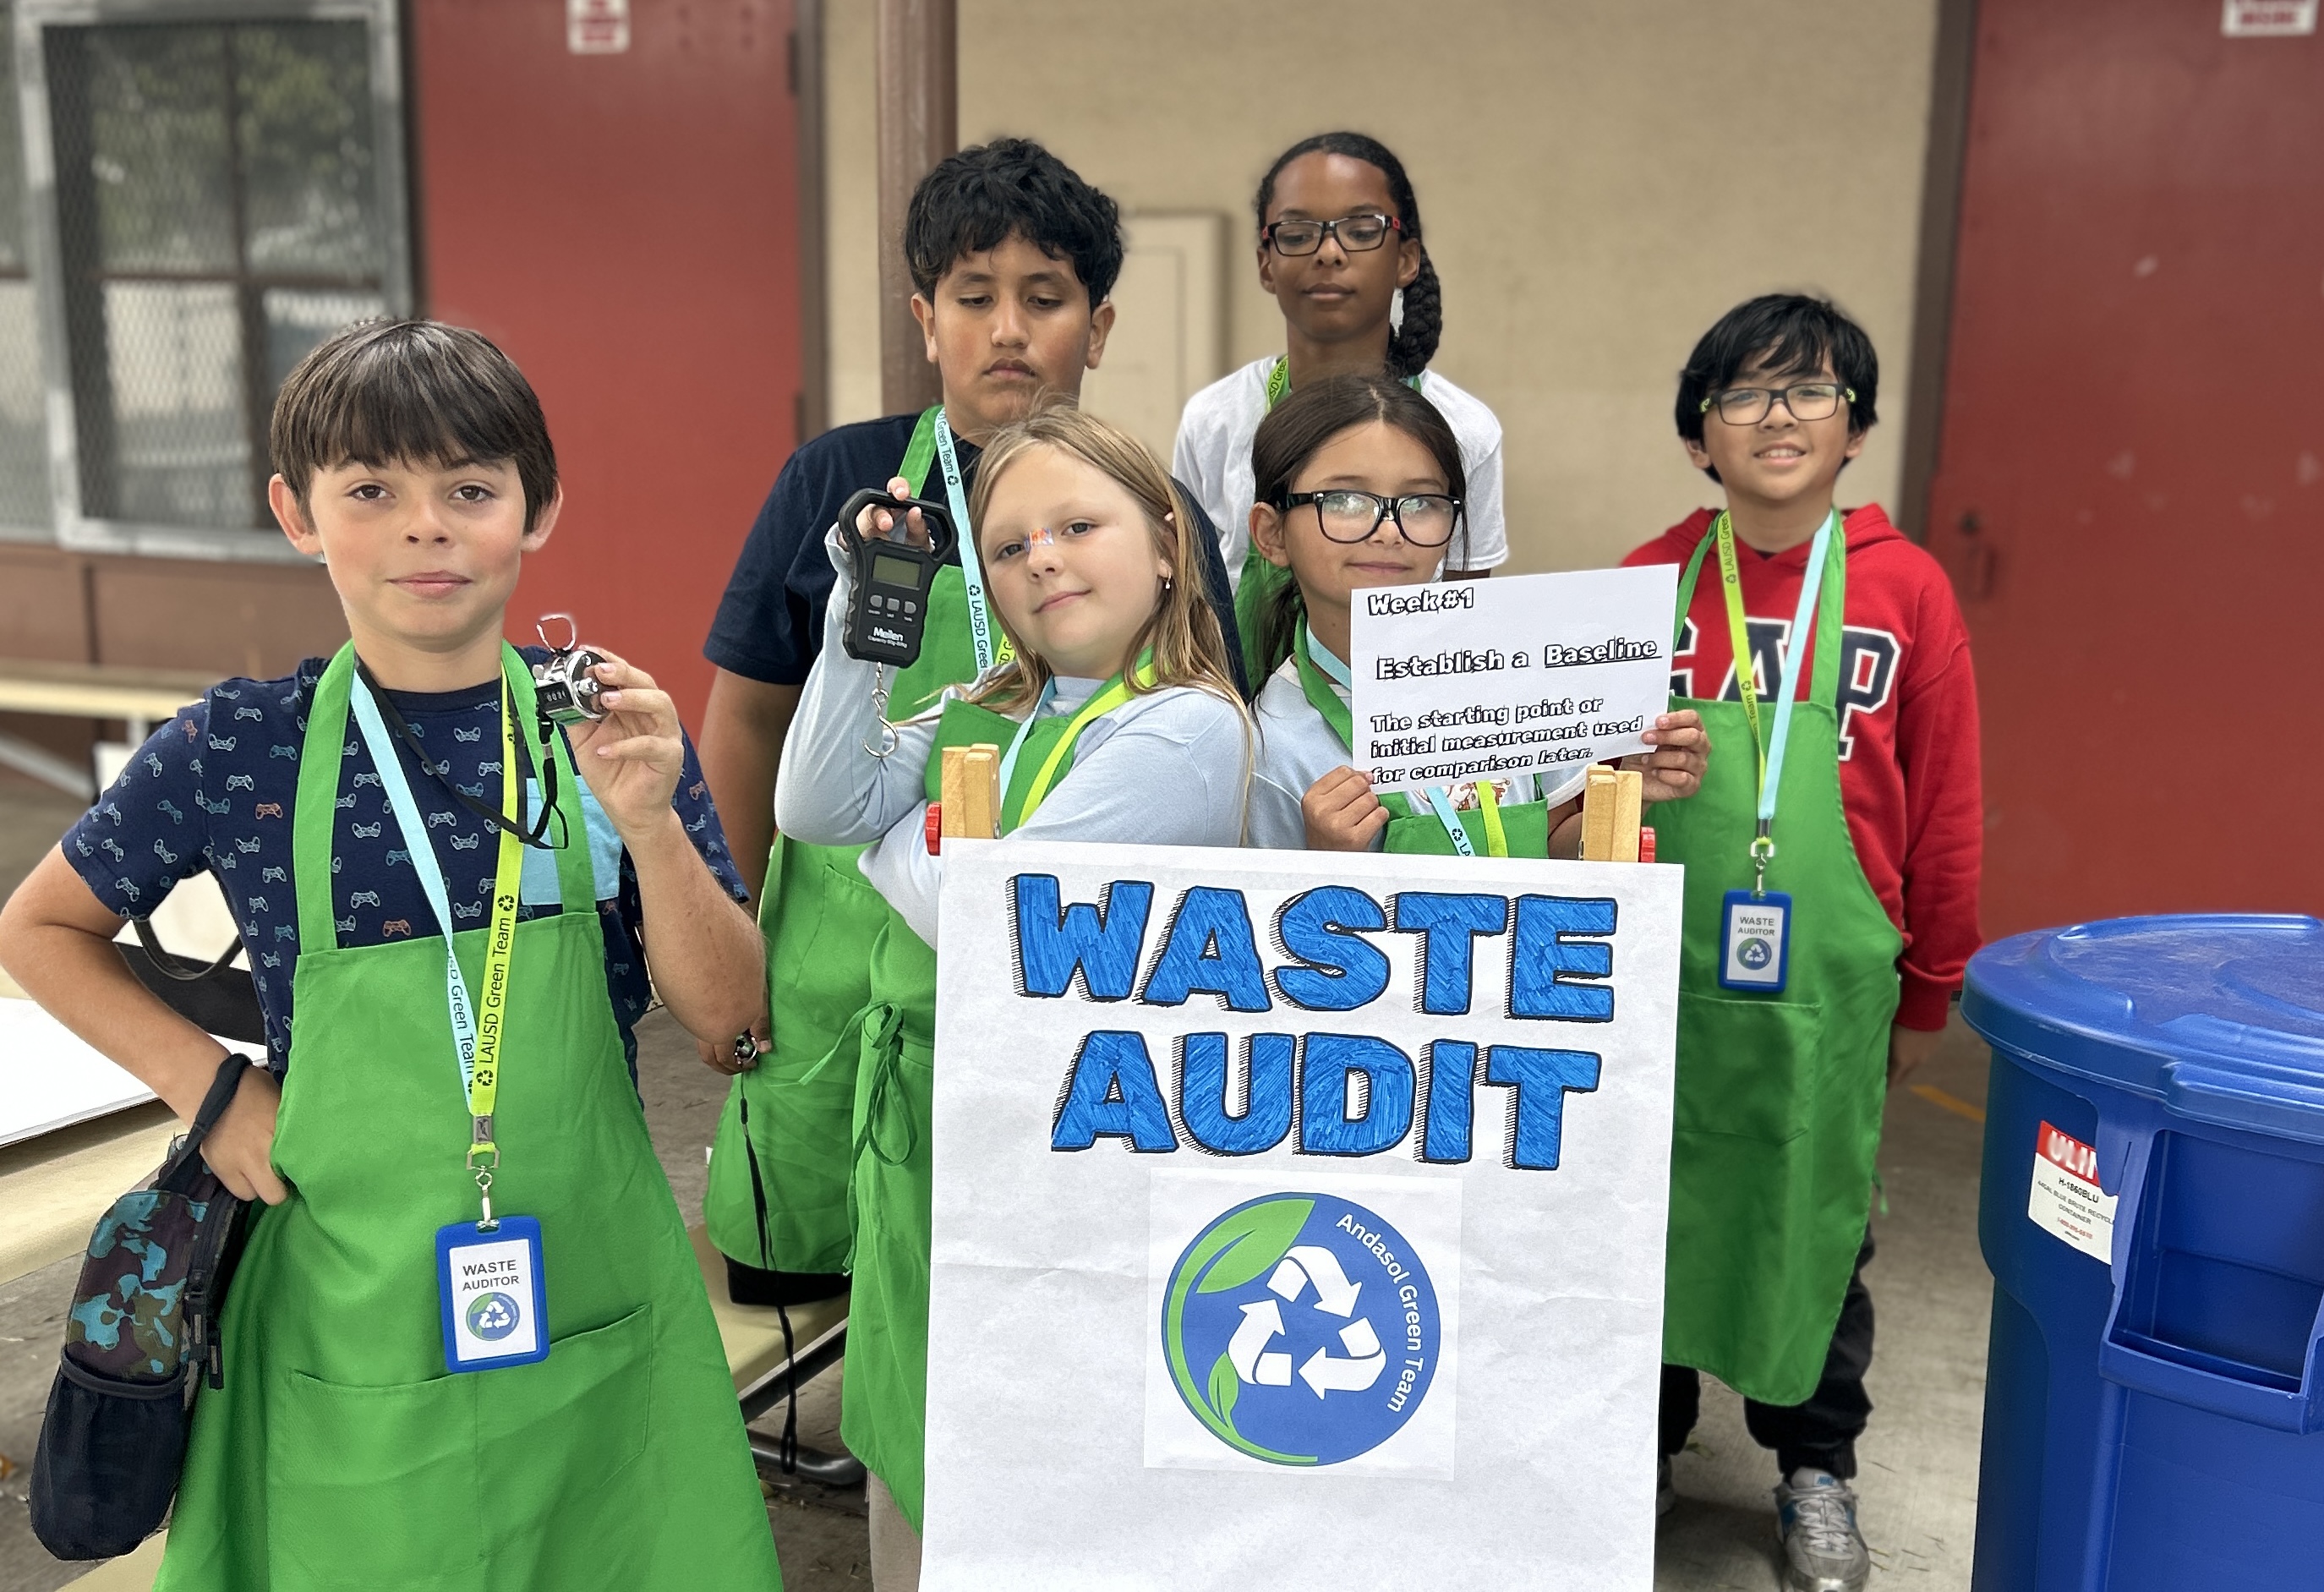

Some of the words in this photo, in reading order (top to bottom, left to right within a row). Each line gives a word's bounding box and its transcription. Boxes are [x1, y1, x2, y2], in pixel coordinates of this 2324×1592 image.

[937, 421, 948, 446] Green
[942, 447, 954, 472] Team
[1721, 542, 1735, 572] LAUSD
[971, 599, 986, 637] LAUSD
[1376, 648, 1505, 680] Establish
[1512, 651, 1529, 668] a
[1544, 637, 1660, 667] Baseline
[1370, 712, 1413, 733] The
[1418, 704, 1509, 730] starting
[1516, 698, 1574, 724] point
[1578, 698, 1604, 714] or
[1370, 734, 1435, 759] initial
[1441, 721, 1588, 752] measurement
[1593, 715, 1643, 737] used
[1372, 766, 1406, 785] for
[1409, 754, 1534, 780] comparison
[1538, 747, 1594, 765] later.
[492, 917, 511, 958] Team
[1737, 927, 1775, 936] AUDITOR
[1740, 916, 1775, 927] WASTE
[1006, 873, 1618, 1021] WASTE
[486, 962, 506, 1009] Green
[451, 985, 468, 1030] Green
[479, 1011, 500, 1064] LAUSD
[1050, 1030, 1603, 1170] AUDIT
[462, 1260, 517, 1276] WASTE
[1335, 1213, 1410, 1284] Andasol
[462, 1276, 519, 1291] AUDITOR
[1398, 1284, 1423, 1351] Green
[1386, 1357, 1424, 1413] Team
